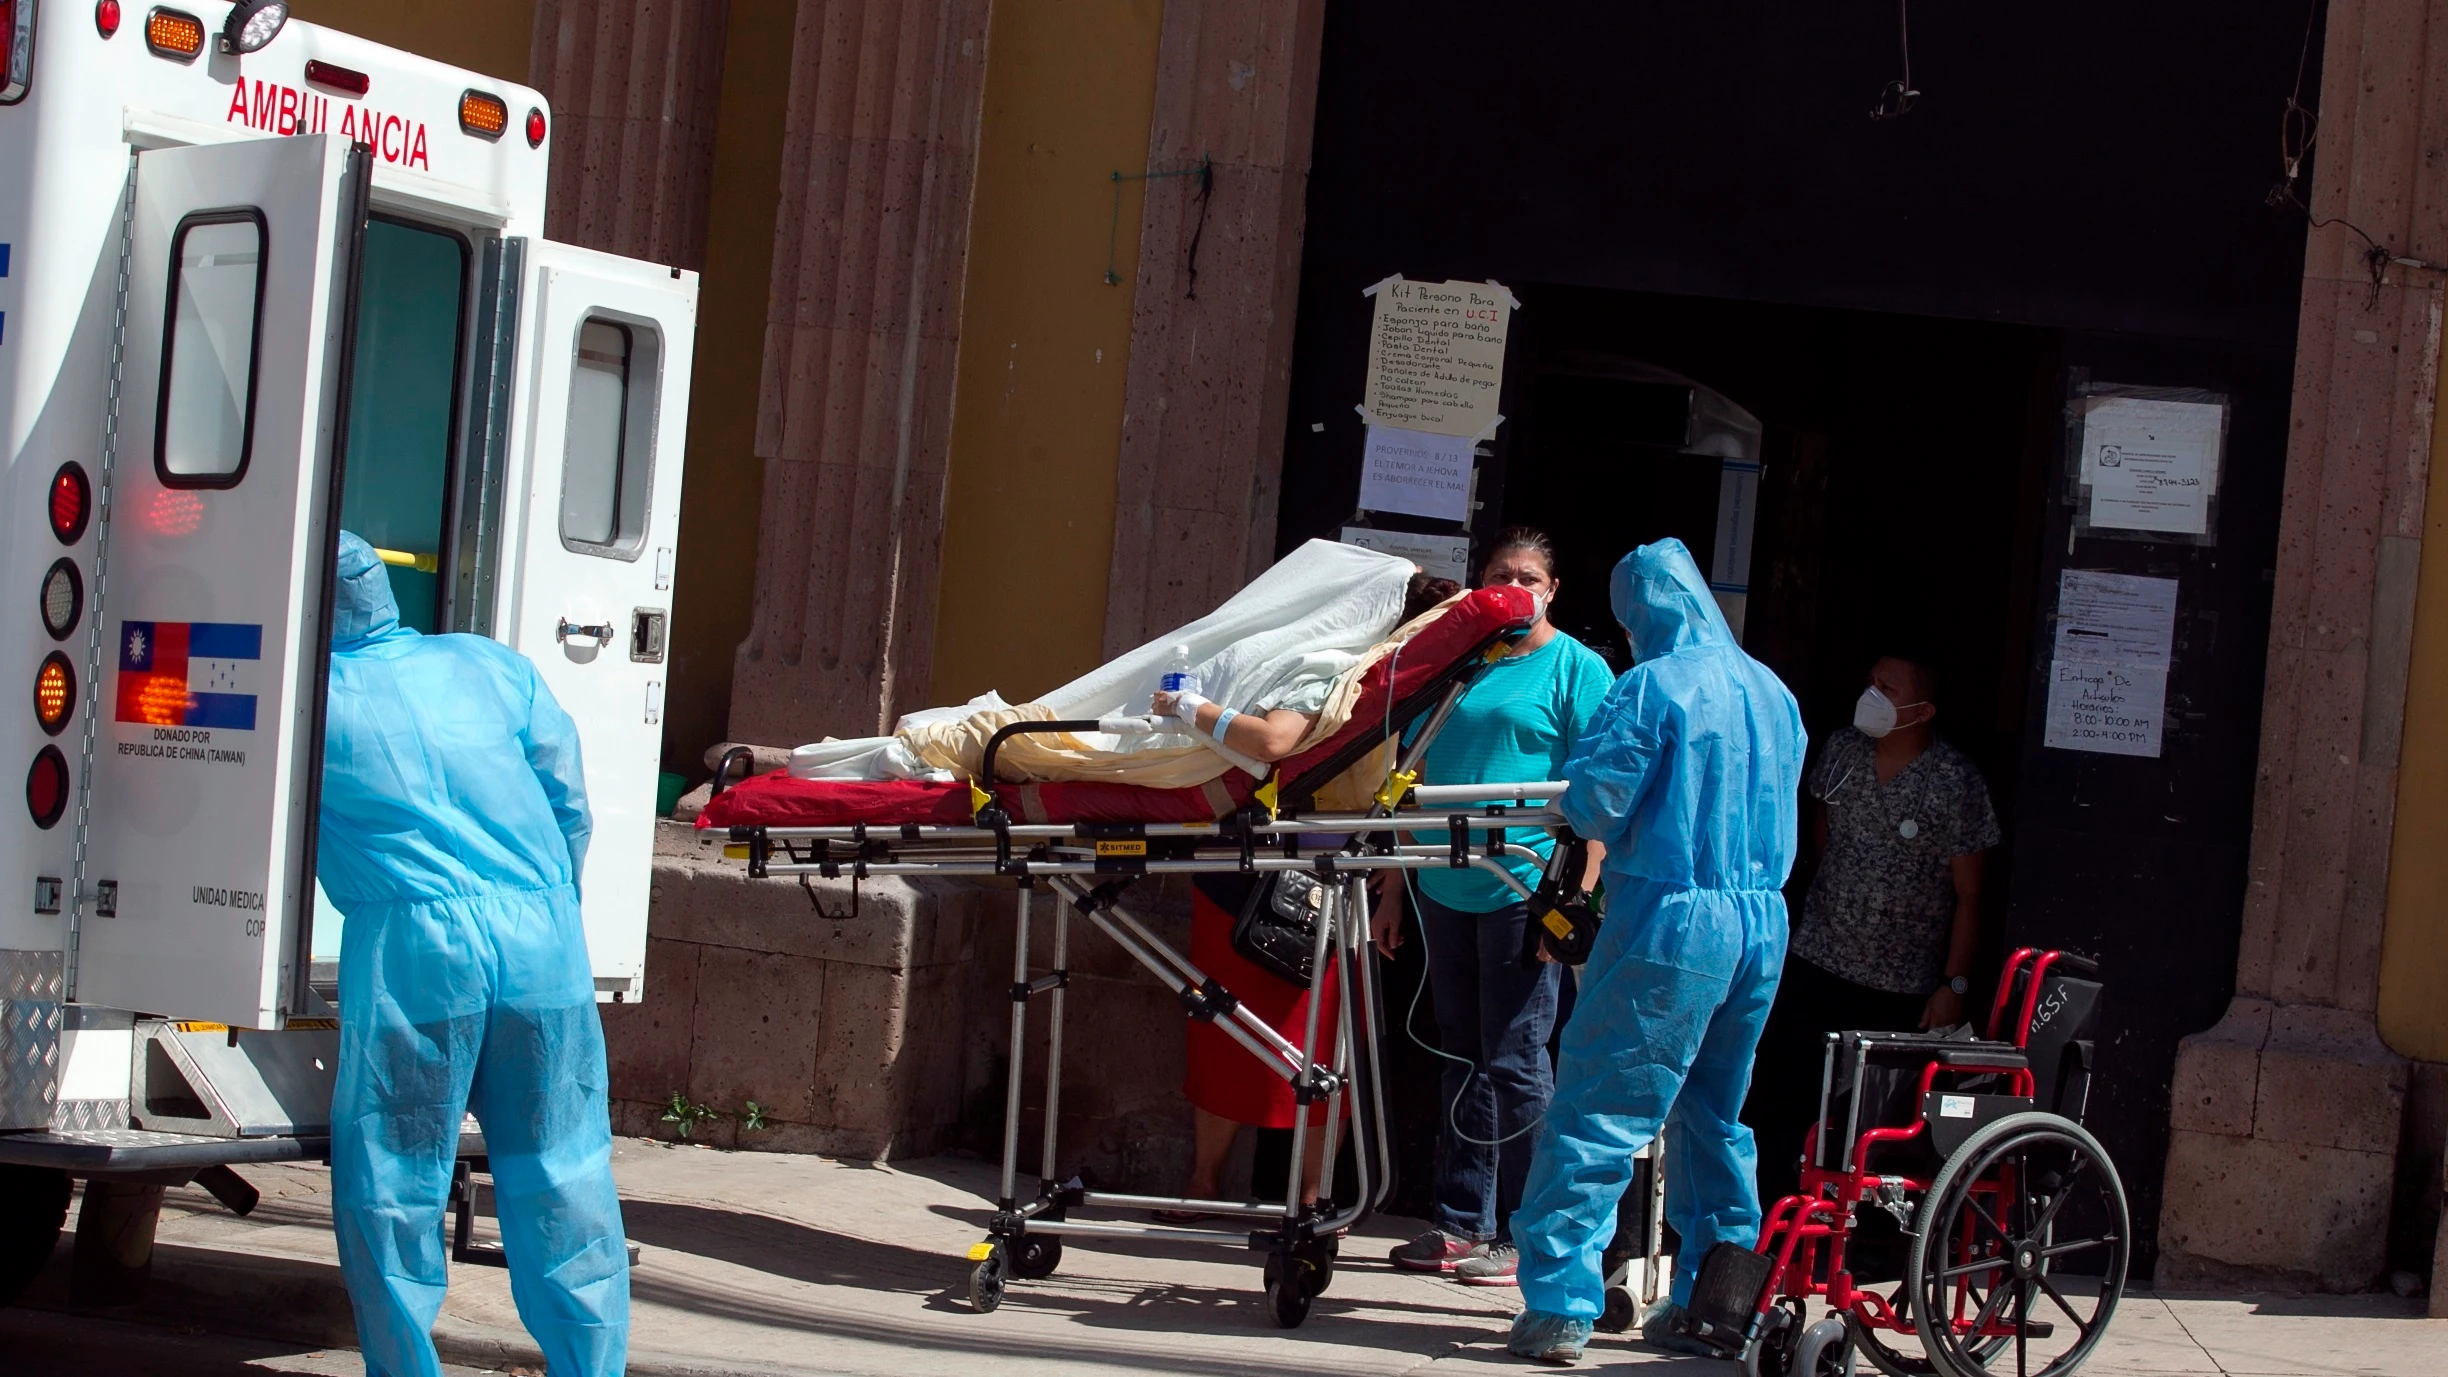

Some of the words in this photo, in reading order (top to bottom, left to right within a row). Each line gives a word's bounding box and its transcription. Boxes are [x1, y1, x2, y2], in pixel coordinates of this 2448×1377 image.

[1392, 284, 1411, 298] Kit
[1470, 293, 1494, 306] Para
[1396, 302, 1440, 314] Paciente
[1382, 333, 1412, 342] Cepillo
[1460, 375, 1470, 384] de
[1449, 454, 1458, 462] 13
[1374, 460, 1383, 468] EL
[1386, 461, 1416, 471] TEMOR
[1426, 466, 1458, 476] JEHOVA
[1384, 475, 1433, 487] ABORRECER
[1447, 482, 1465, 491] MAL
[2060, 667, 2104, 691] Entrega
[2114, 675, 2132, 687] De
[2133, 719, 2149, 729] AM
[153, 728, 190, 743] DONADO
[192, 731, 210, 744] POR
[2129, 733, 2147, 743] PM
[118, 743, 164, 758] REPUBLICA
[166, 747, 178, 759] DE
[179, 747, 205, 761] CHINA
[207, 749, 245, 766] (TAIWAN)
[193, 886, 227, 906] UNIDAD
[229, 890, 264, 911] MEDICA
